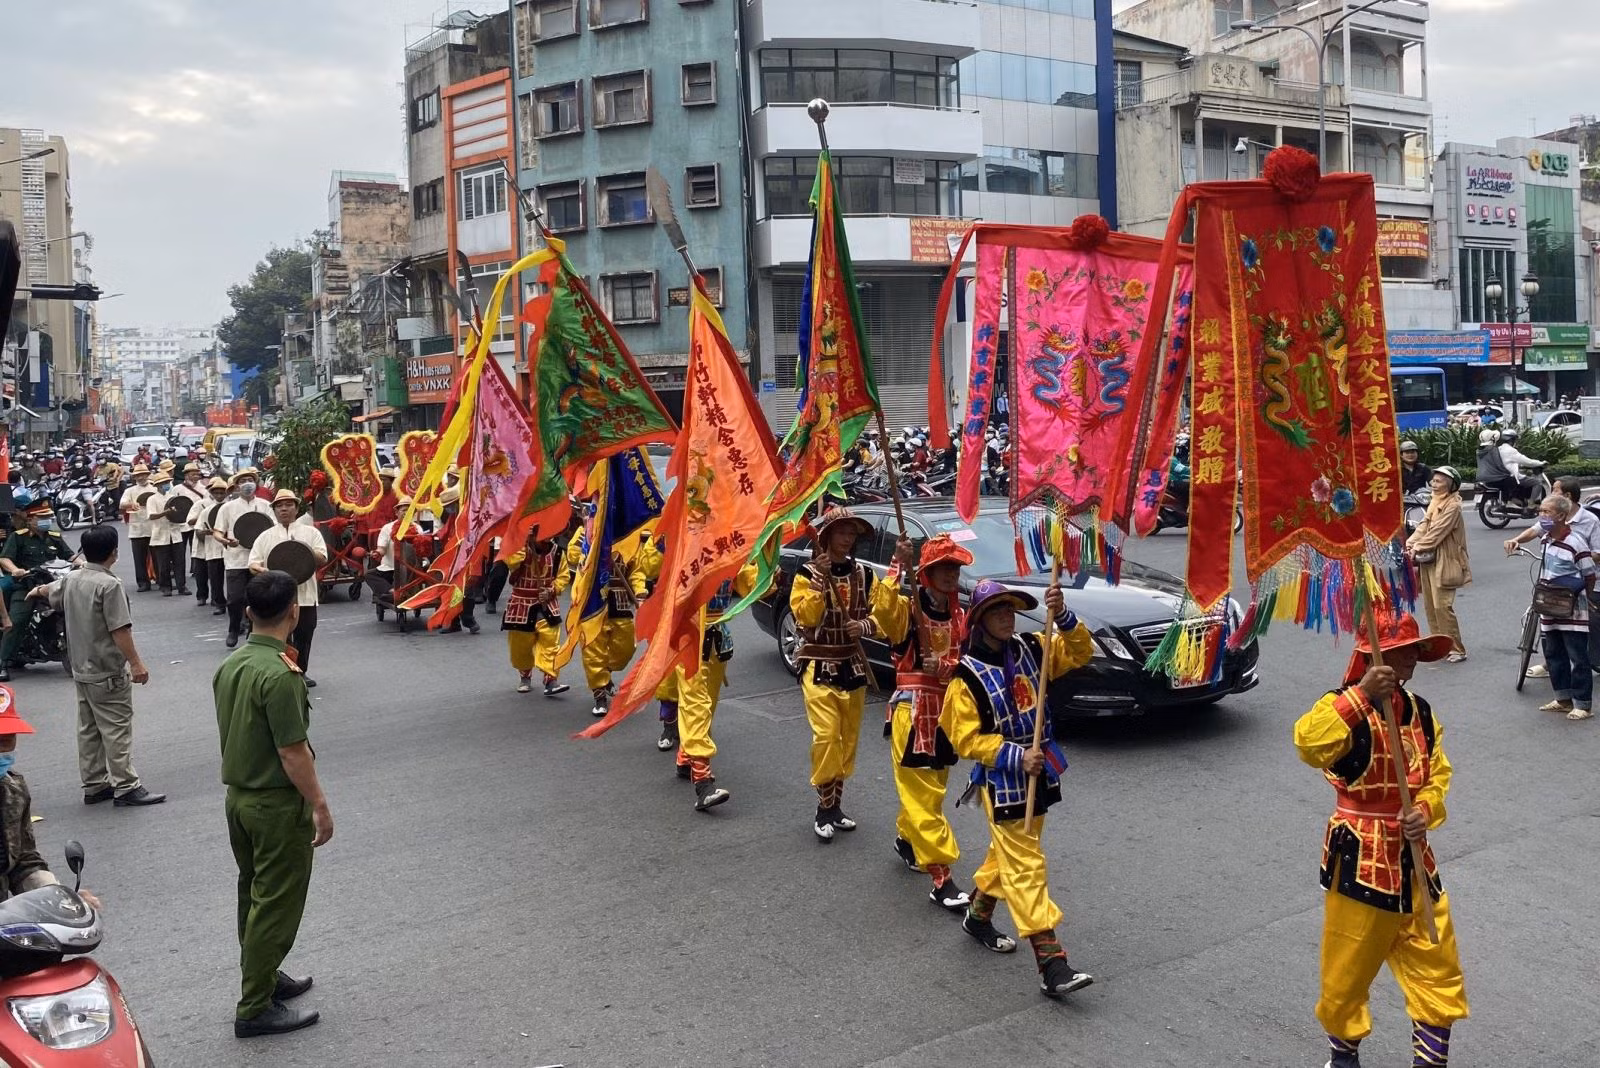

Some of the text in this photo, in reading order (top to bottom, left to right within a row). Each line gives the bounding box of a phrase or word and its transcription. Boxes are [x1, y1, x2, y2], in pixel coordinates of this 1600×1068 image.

[1541, 153, 1569, 171] OCB
[406, 359, 425, 378] H&H
[424, 378, 450, 390] VNXK
